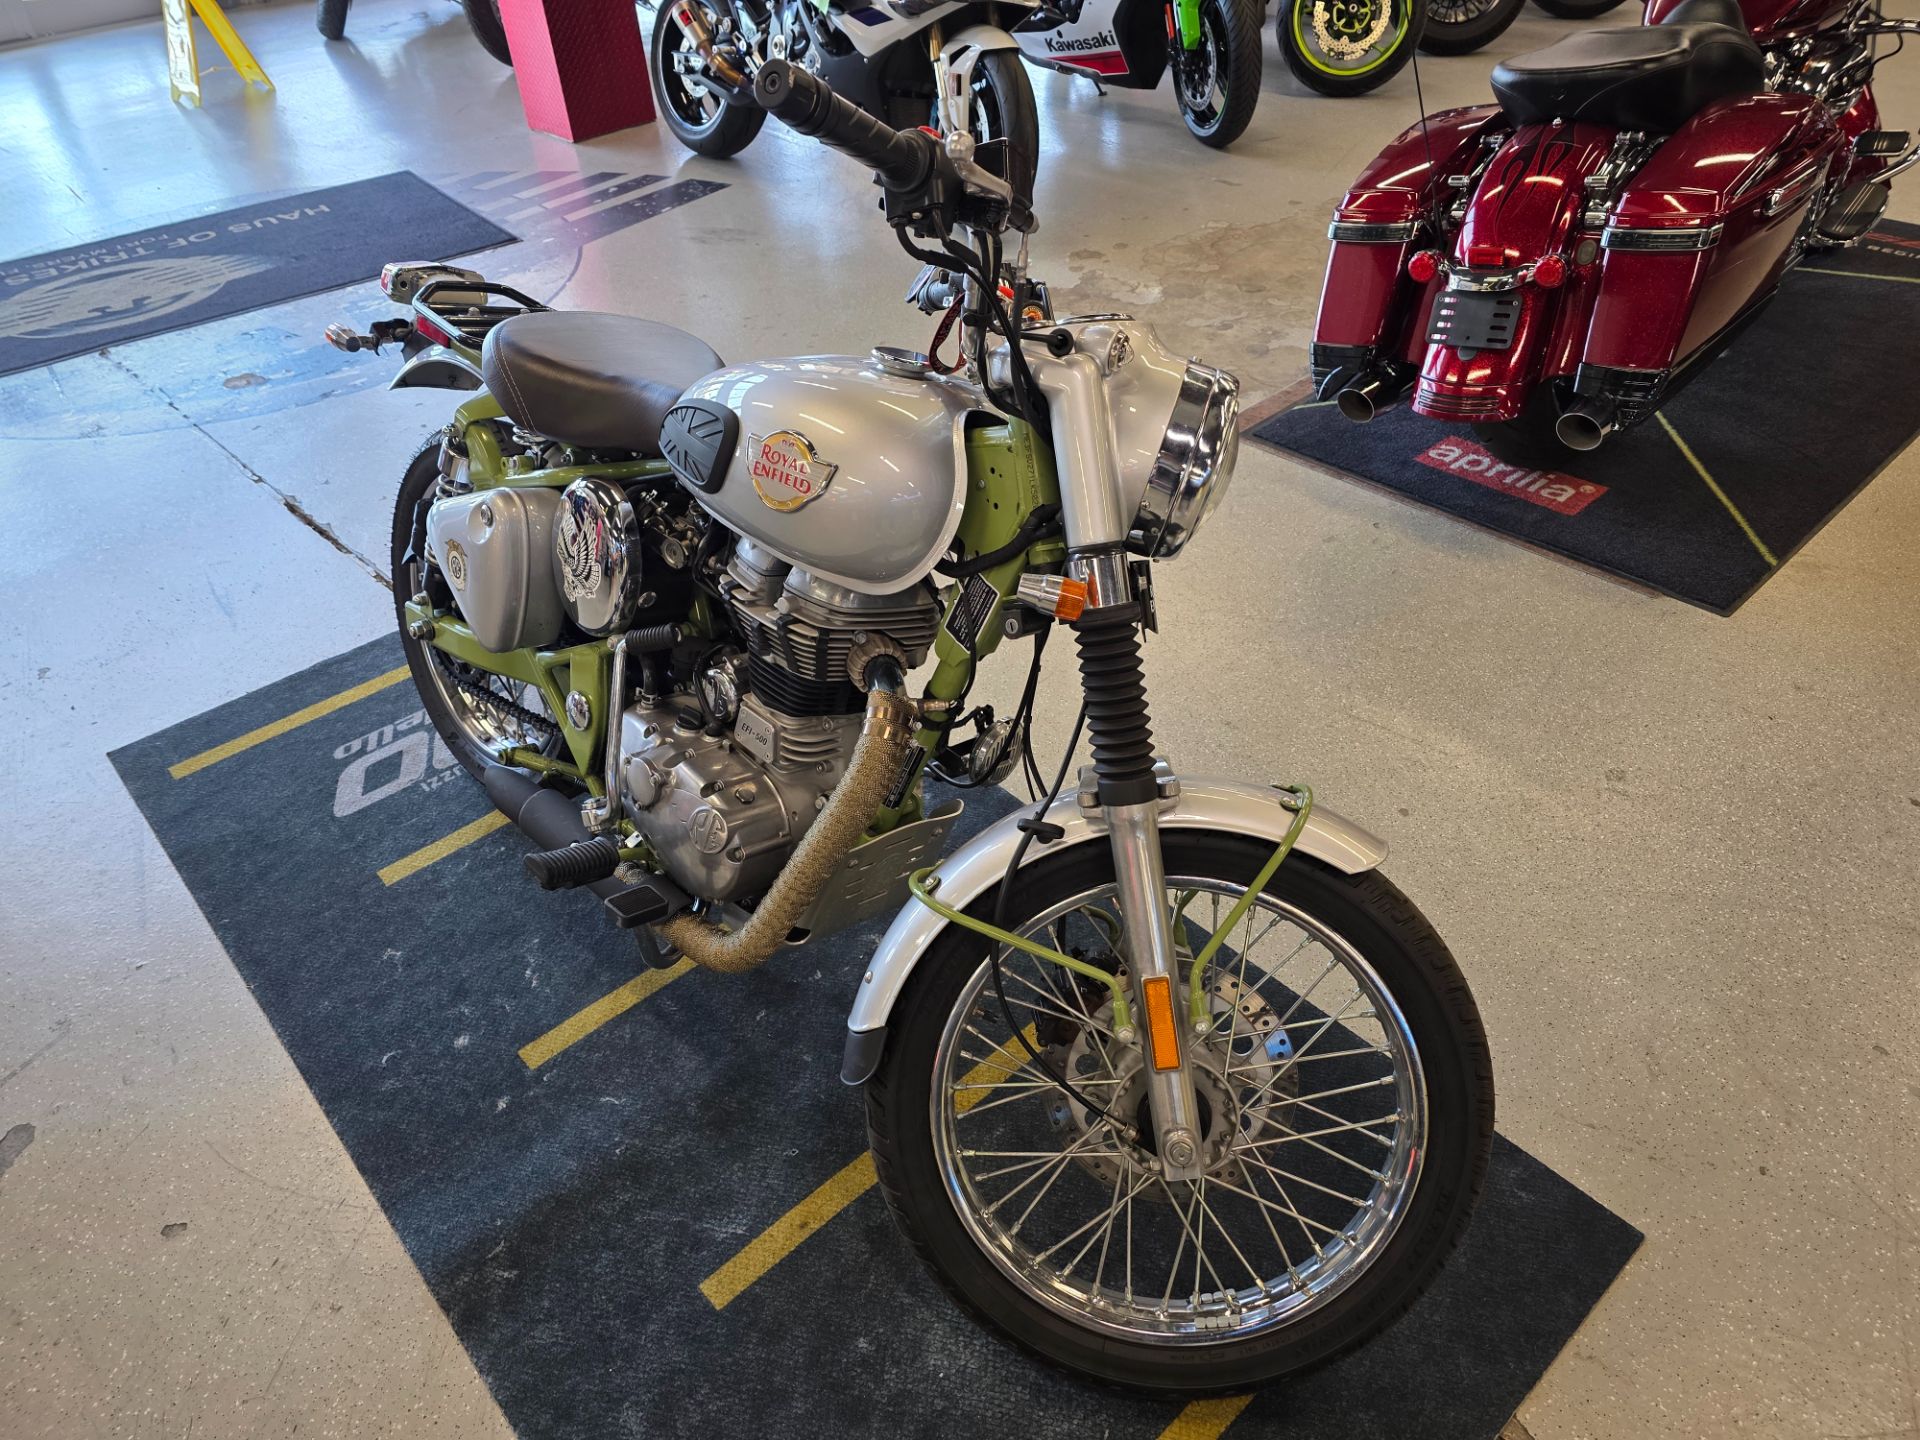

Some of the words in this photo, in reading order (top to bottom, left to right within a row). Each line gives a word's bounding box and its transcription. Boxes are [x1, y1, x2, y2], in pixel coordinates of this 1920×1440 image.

[1044, 30, 1117, 52] Kawasaki
[227, 204, 331, 233] HAUS
[116, 234, 169, 249] FORT
[167, 231, 217, 249] OF
[4, 247, 155, 286] TRIKES
[760, 443, 808, 475] ROYAL
[753, 460, 812, 495] ENFIELD
